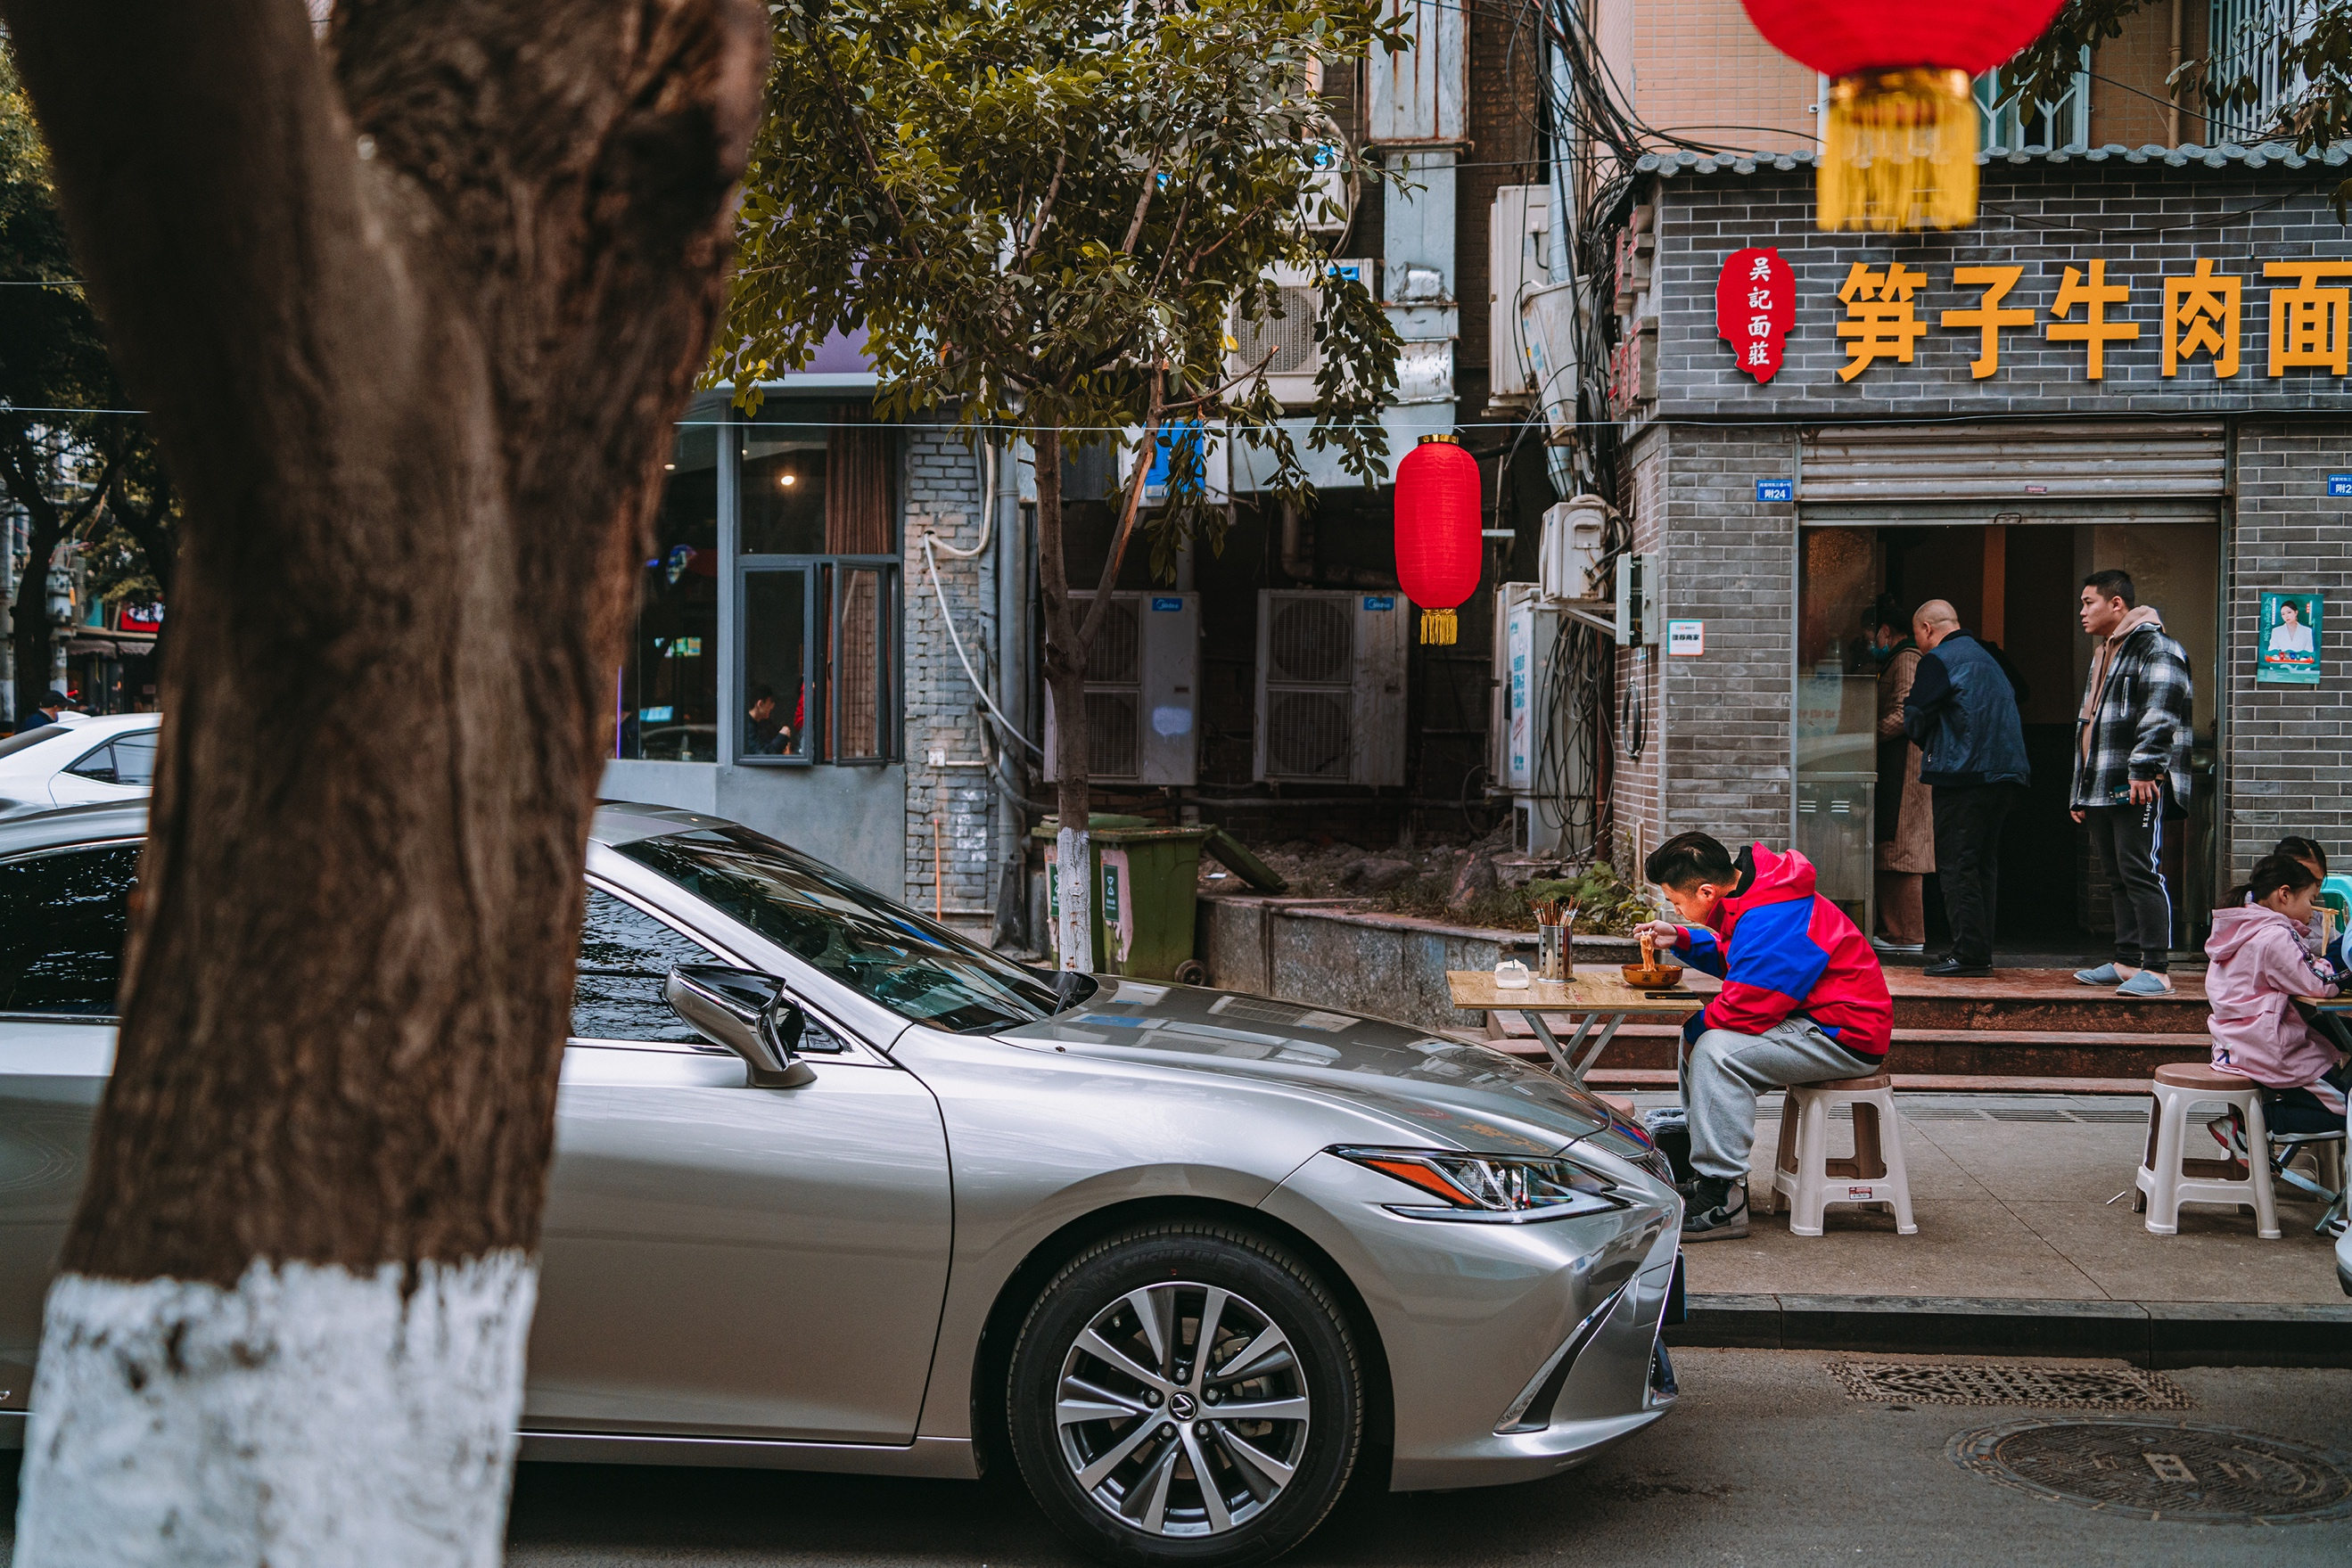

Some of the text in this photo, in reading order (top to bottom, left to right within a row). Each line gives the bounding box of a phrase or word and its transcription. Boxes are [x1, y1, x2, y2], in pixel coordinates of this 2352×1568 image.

[1837, 258, 2351, 382] 笋子牛肉面
